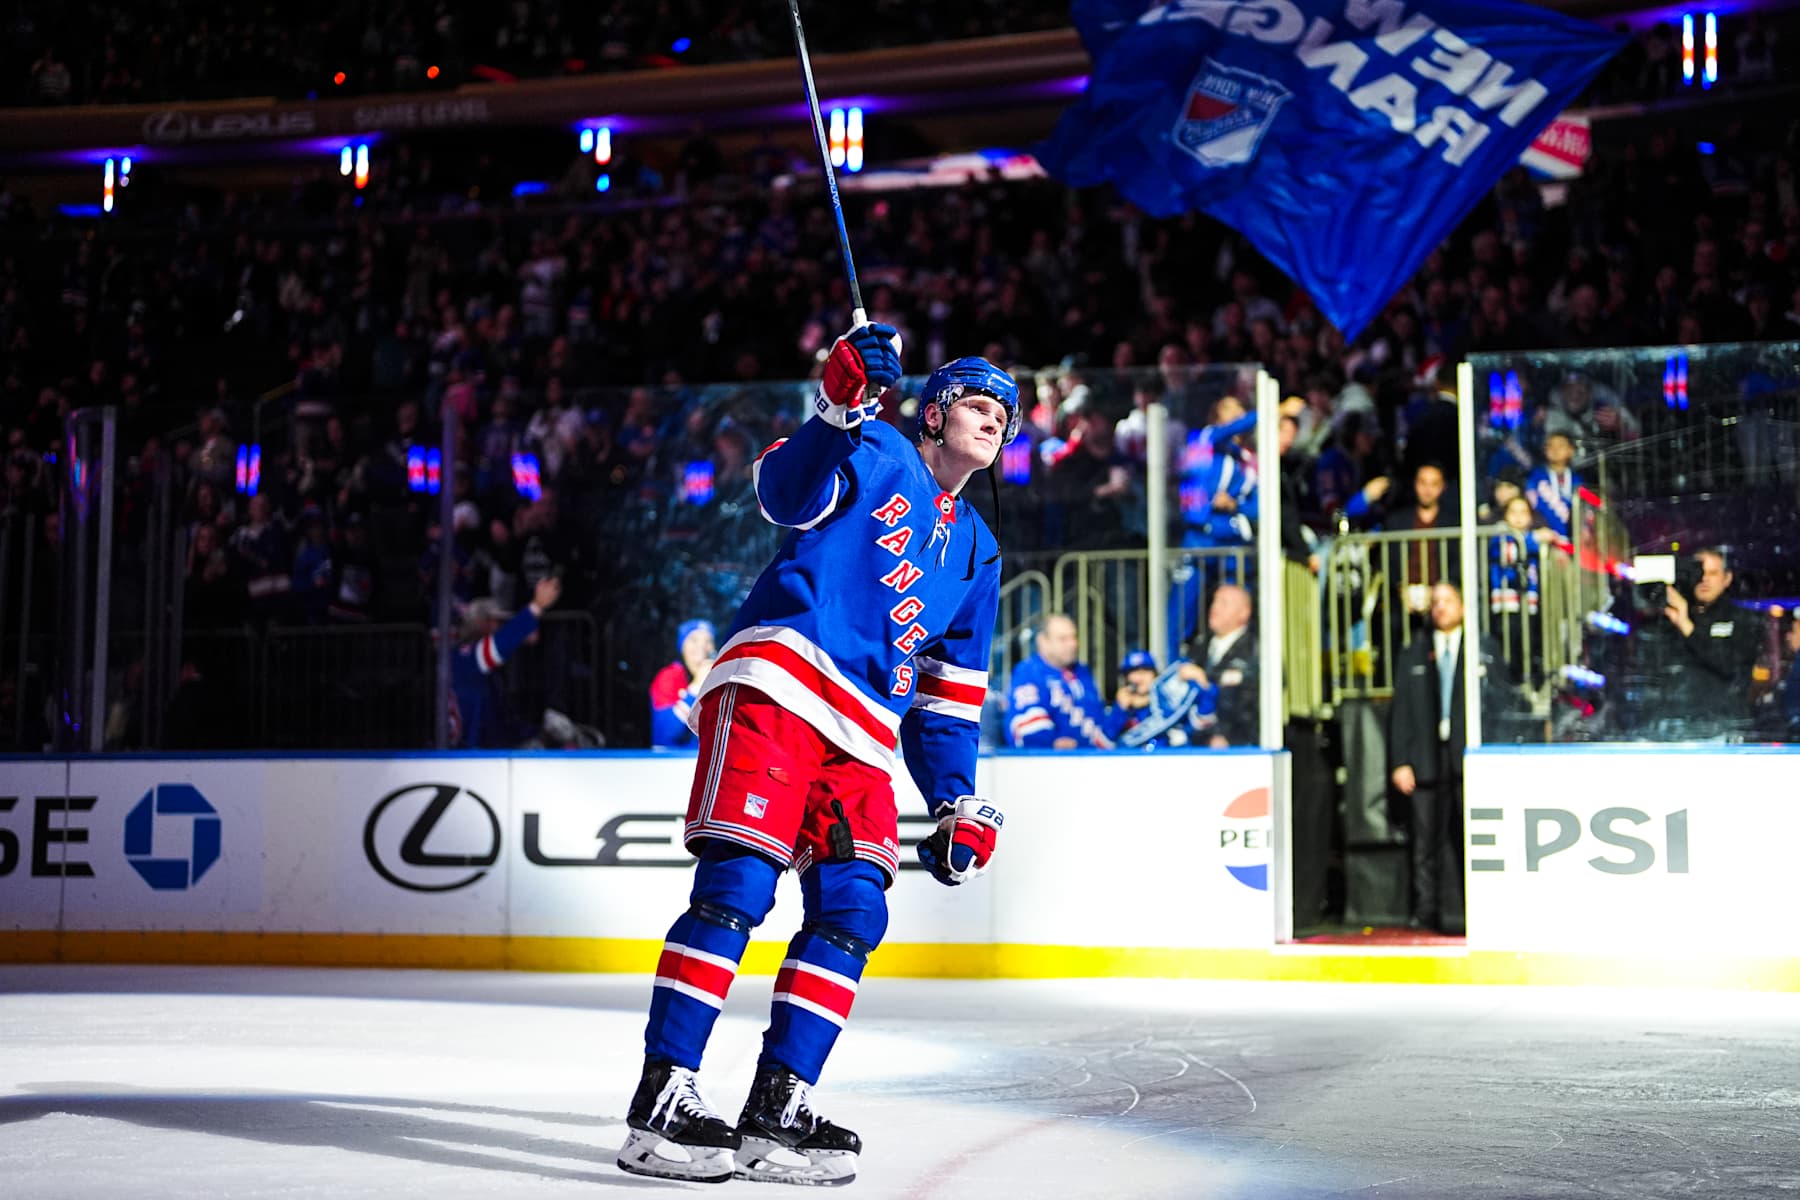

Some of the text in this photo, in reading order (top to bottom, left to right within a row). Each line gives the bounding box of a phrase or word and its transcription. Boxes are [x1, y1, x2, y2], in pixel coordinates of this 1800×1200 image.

[191, 110, 317, 138] LEXUS
[871, 492, 929, 697] RANGES
[1220, 829, 1273, 849] PE
